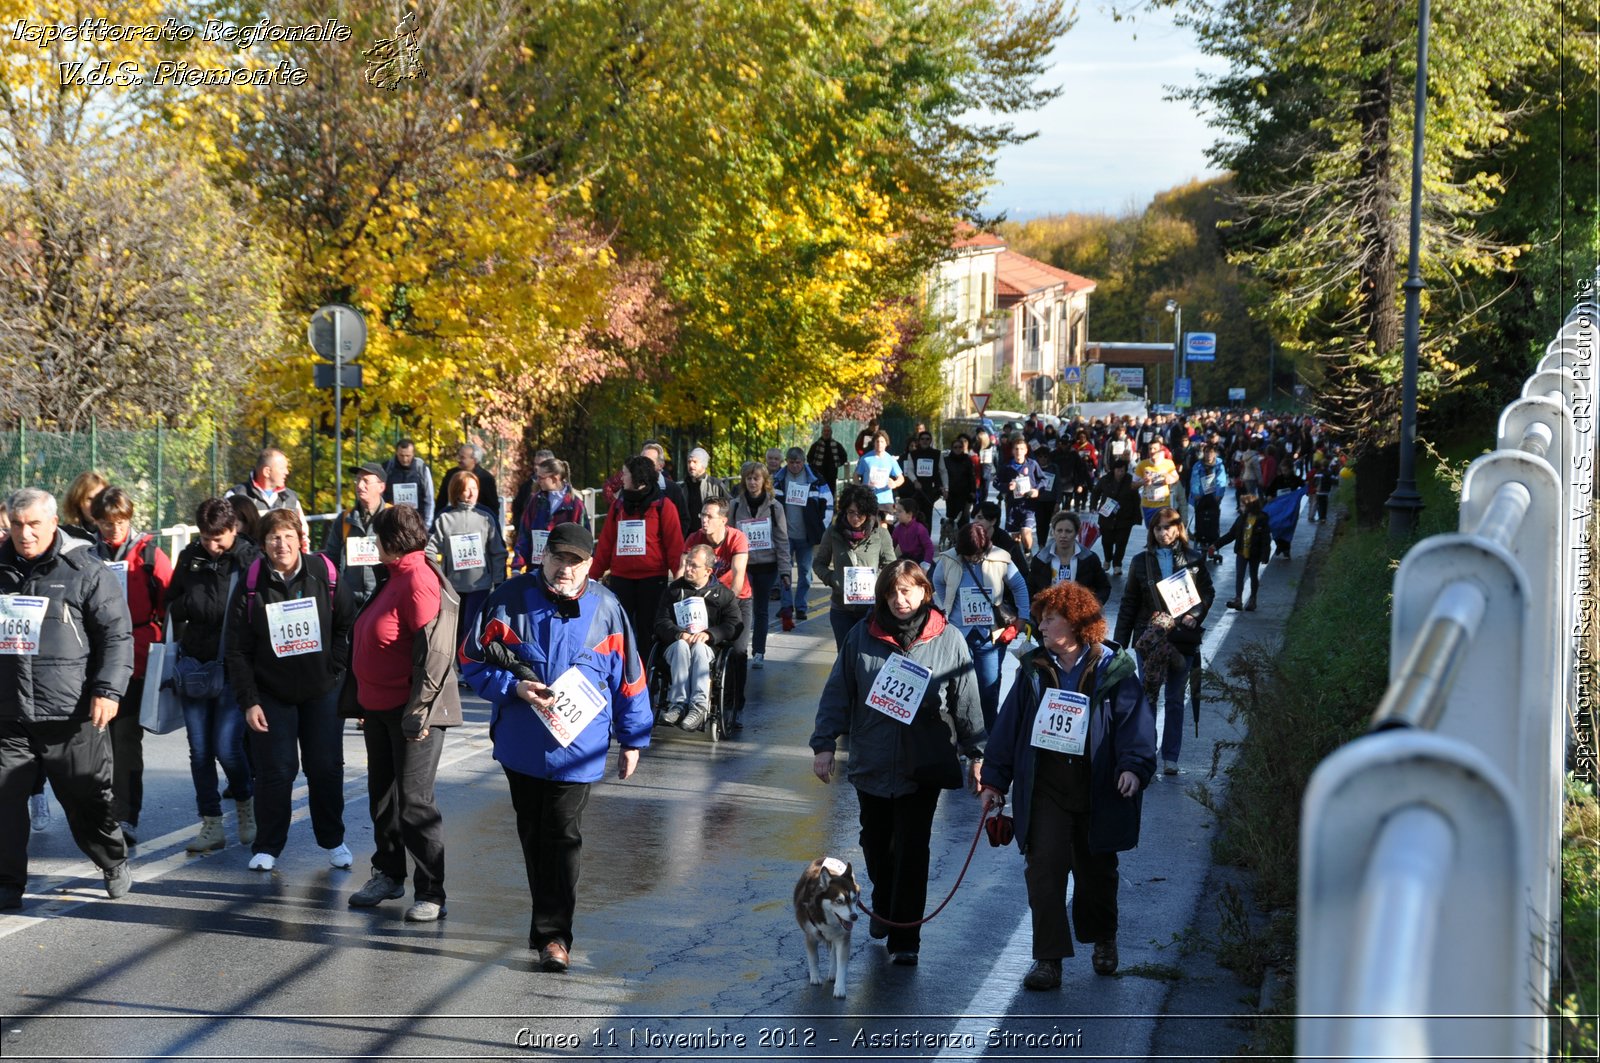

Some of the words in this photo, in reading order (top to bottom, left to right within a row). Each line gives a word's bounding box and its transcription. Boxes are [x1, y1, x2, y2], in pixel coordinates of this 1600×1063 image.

[621, 533, 640, 544] 3231
[458, 547, 478, 559] 3246
[849, 581, 872, 593] 13141
[967, 601, 987, 613] 1617
[2, 618, 31, 636] 1668
[280, 620, 310, 640] 1669
[275, 640, 319, 655] ipercoop
[881, 675, 915, 703] 3232
[870, 691, 911, 718] ipercoop
[1048, 699, 1083, 715] ipercoop
[1049, 712, 1073, 734] 195
